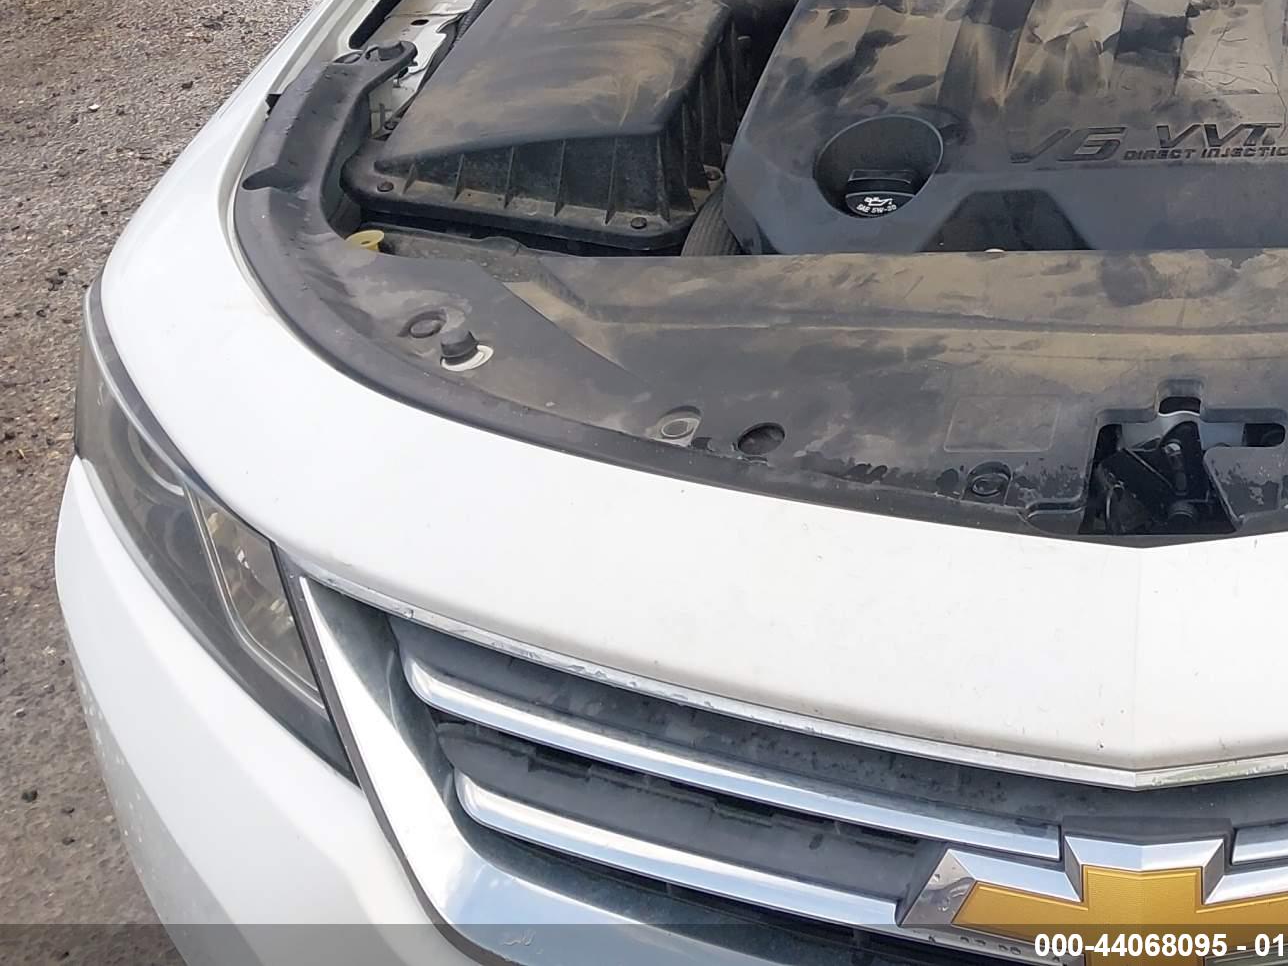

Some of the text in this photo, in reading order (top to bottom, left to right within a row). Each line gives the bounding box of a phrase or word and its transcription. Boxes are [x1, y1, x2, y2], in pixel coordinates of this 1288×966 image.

[1010, 123, 1282, 164] V6 VVT
[1123, 148, 1195, 161] DIRECT
